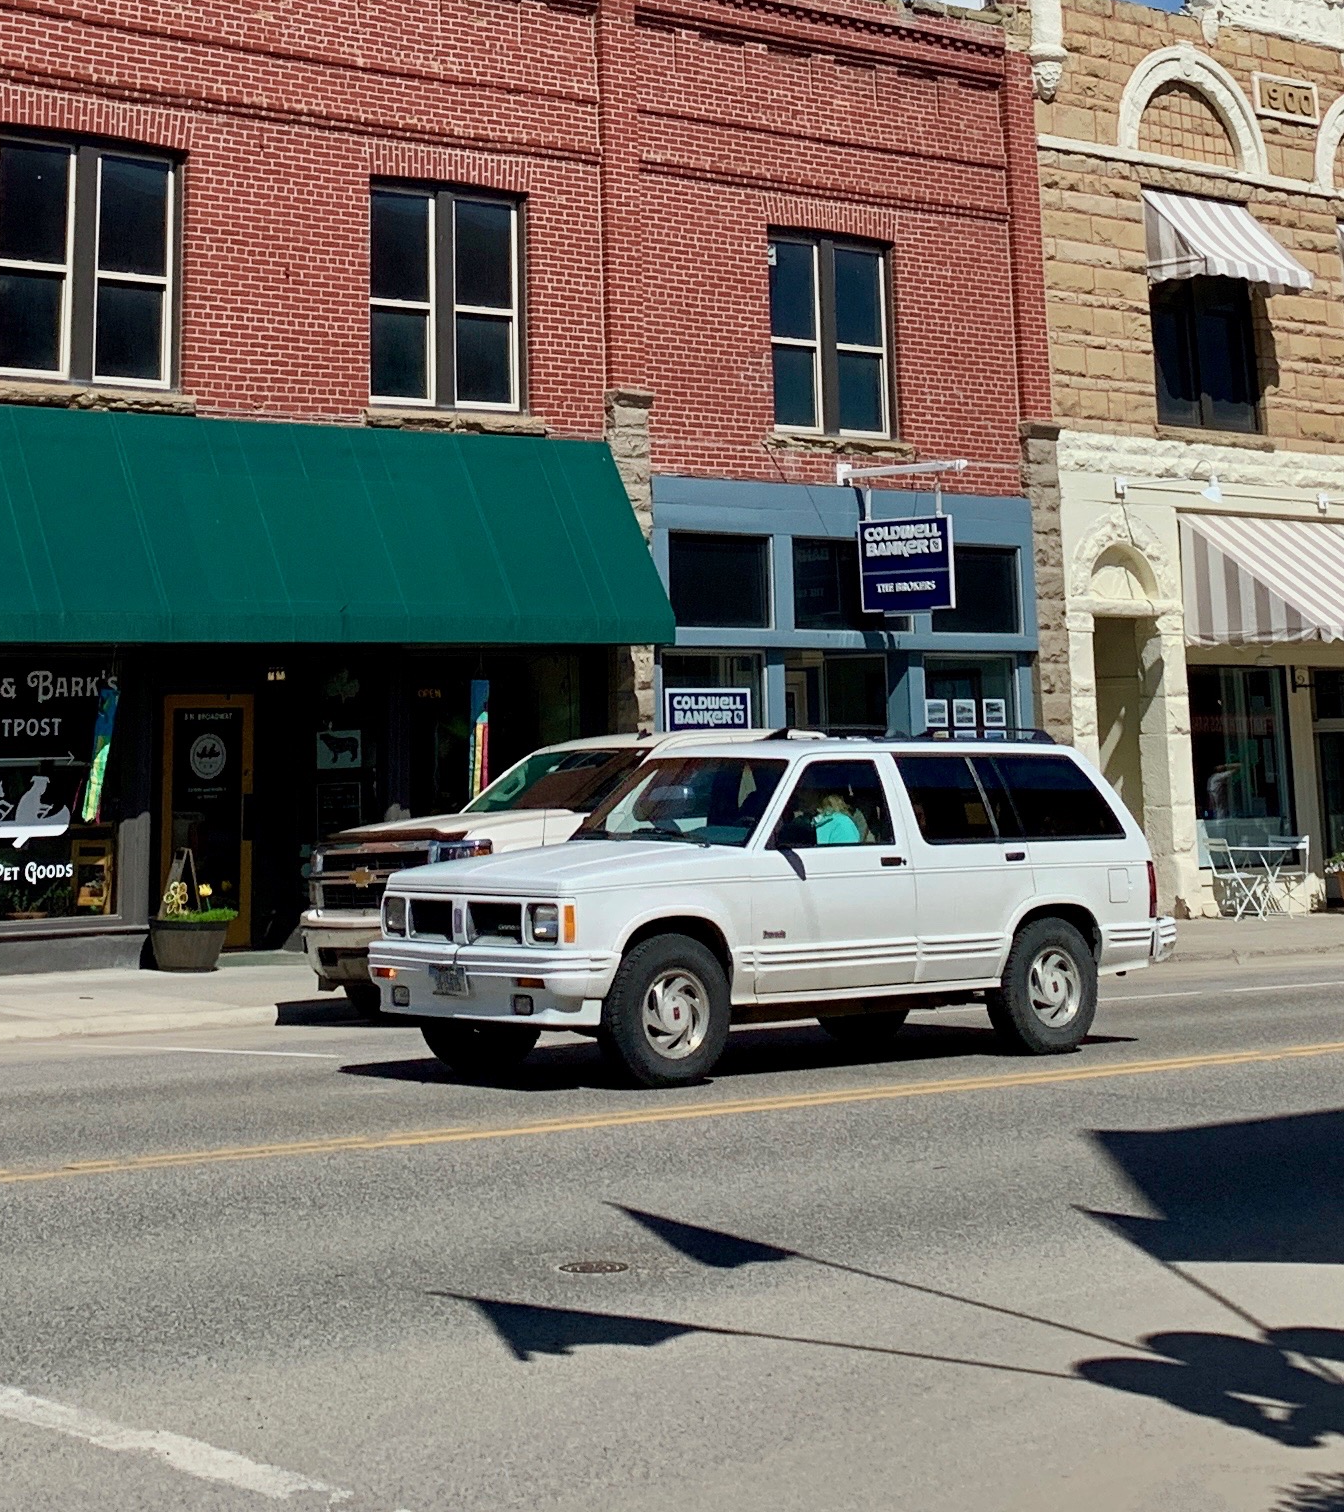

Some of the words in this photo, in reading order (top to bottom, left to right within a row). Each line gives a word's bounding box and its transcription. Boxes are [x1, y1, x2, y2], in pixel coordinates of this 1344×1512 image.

[1259, 81, 1313, 117] 1900
[864, 522, 942, 542] COLDWELL
[866, 538, 930, 558] BANKER
[876, 583, 895, 594] THE
[895, 580, 937, 593] BROKERS
[0, 678, 17, 700] &
[417, 688, 442, 699] OPEN
[673, 695, 745, 710] COLDWELL
[674, 710, 733, 727] BANKER
[24, 861, 74, 885] GOODS
